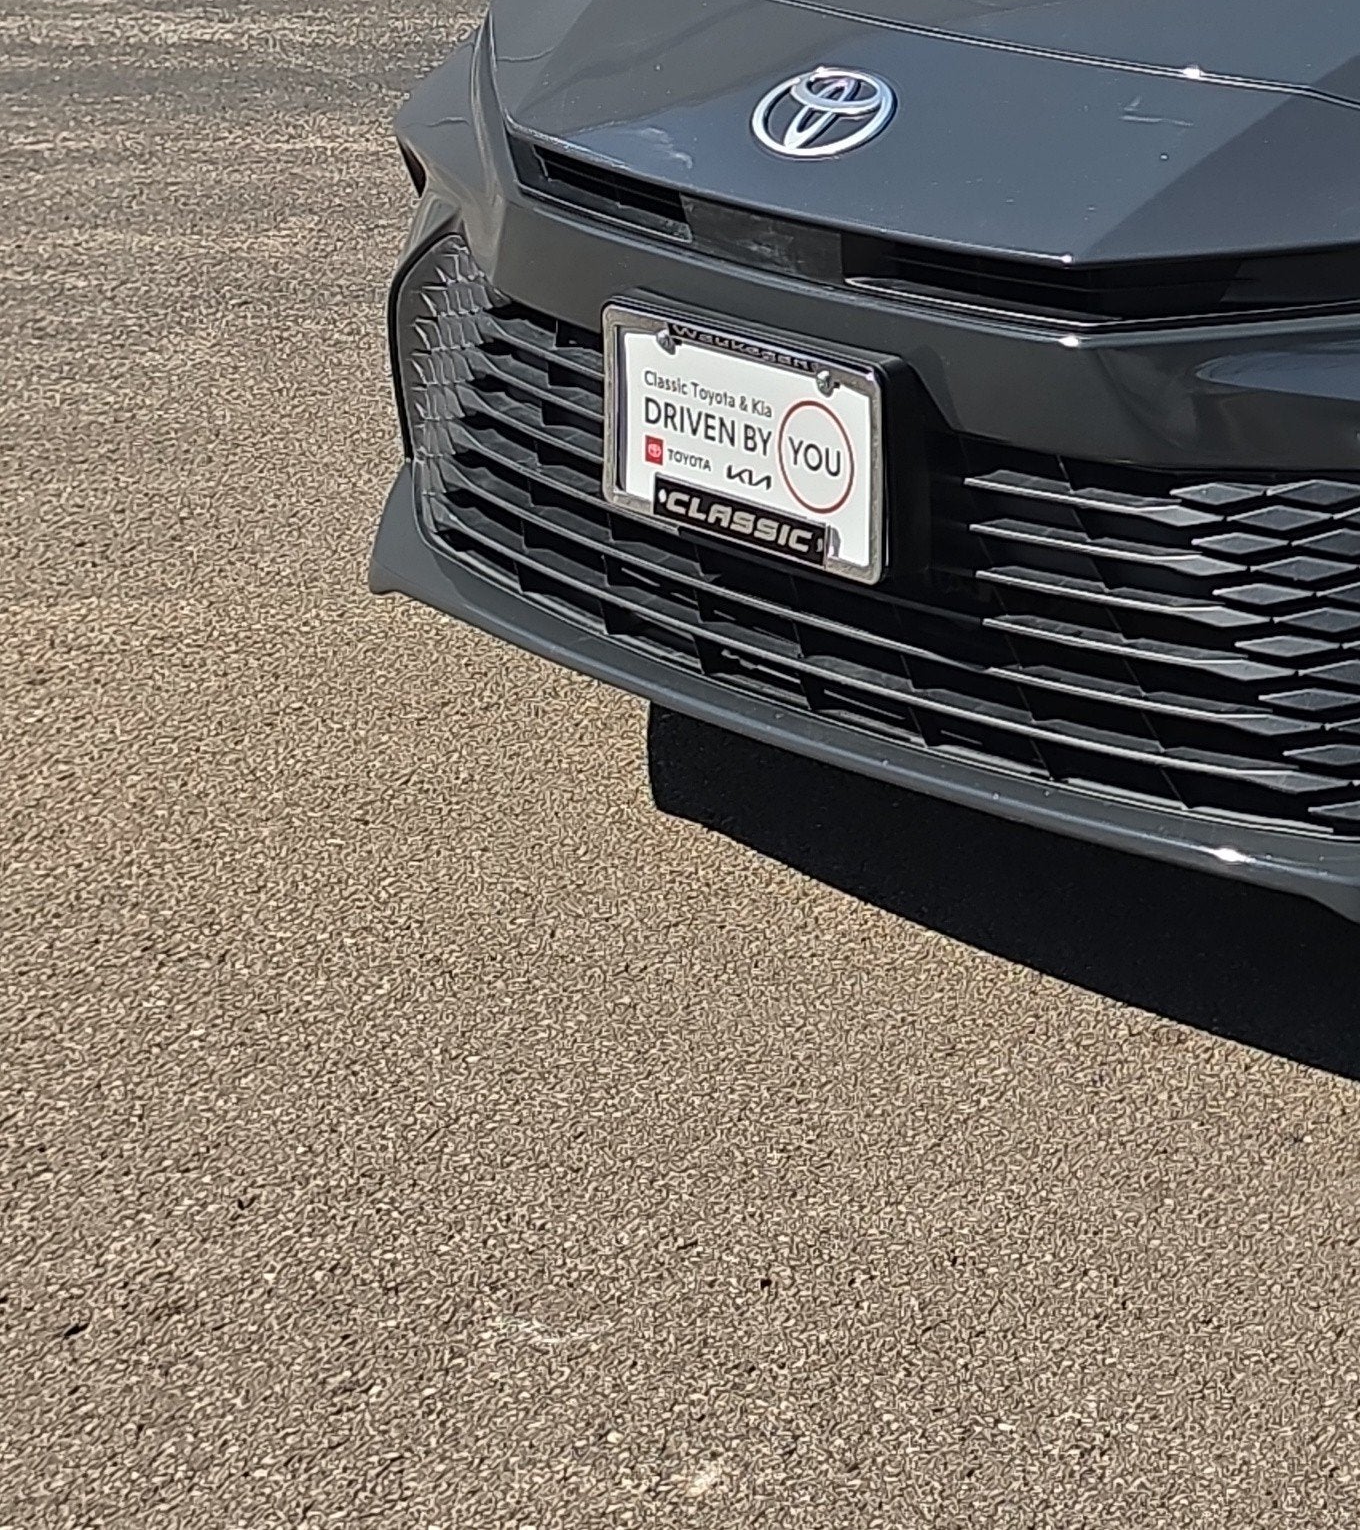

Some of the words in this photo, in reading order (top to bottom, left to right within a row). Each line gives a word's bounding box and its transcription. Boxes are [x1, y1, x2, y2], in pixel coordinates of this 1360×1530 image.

[672, 324, 808, 369] Waukegan
[644, 370, 688, 395] Classic
[690, 381, 736, 408] Toyota
[739, 396, 748, 412] &
[751, 398, 772, 418] Kia
[644, 396, 735, 447] DRIVEN
[743, 425, 772, 456] BY
[788, 436, 841, 477] YOU
[667, 448, 712, 471] TOYOTA
[666, 491, 812, 553] CLASSIC
